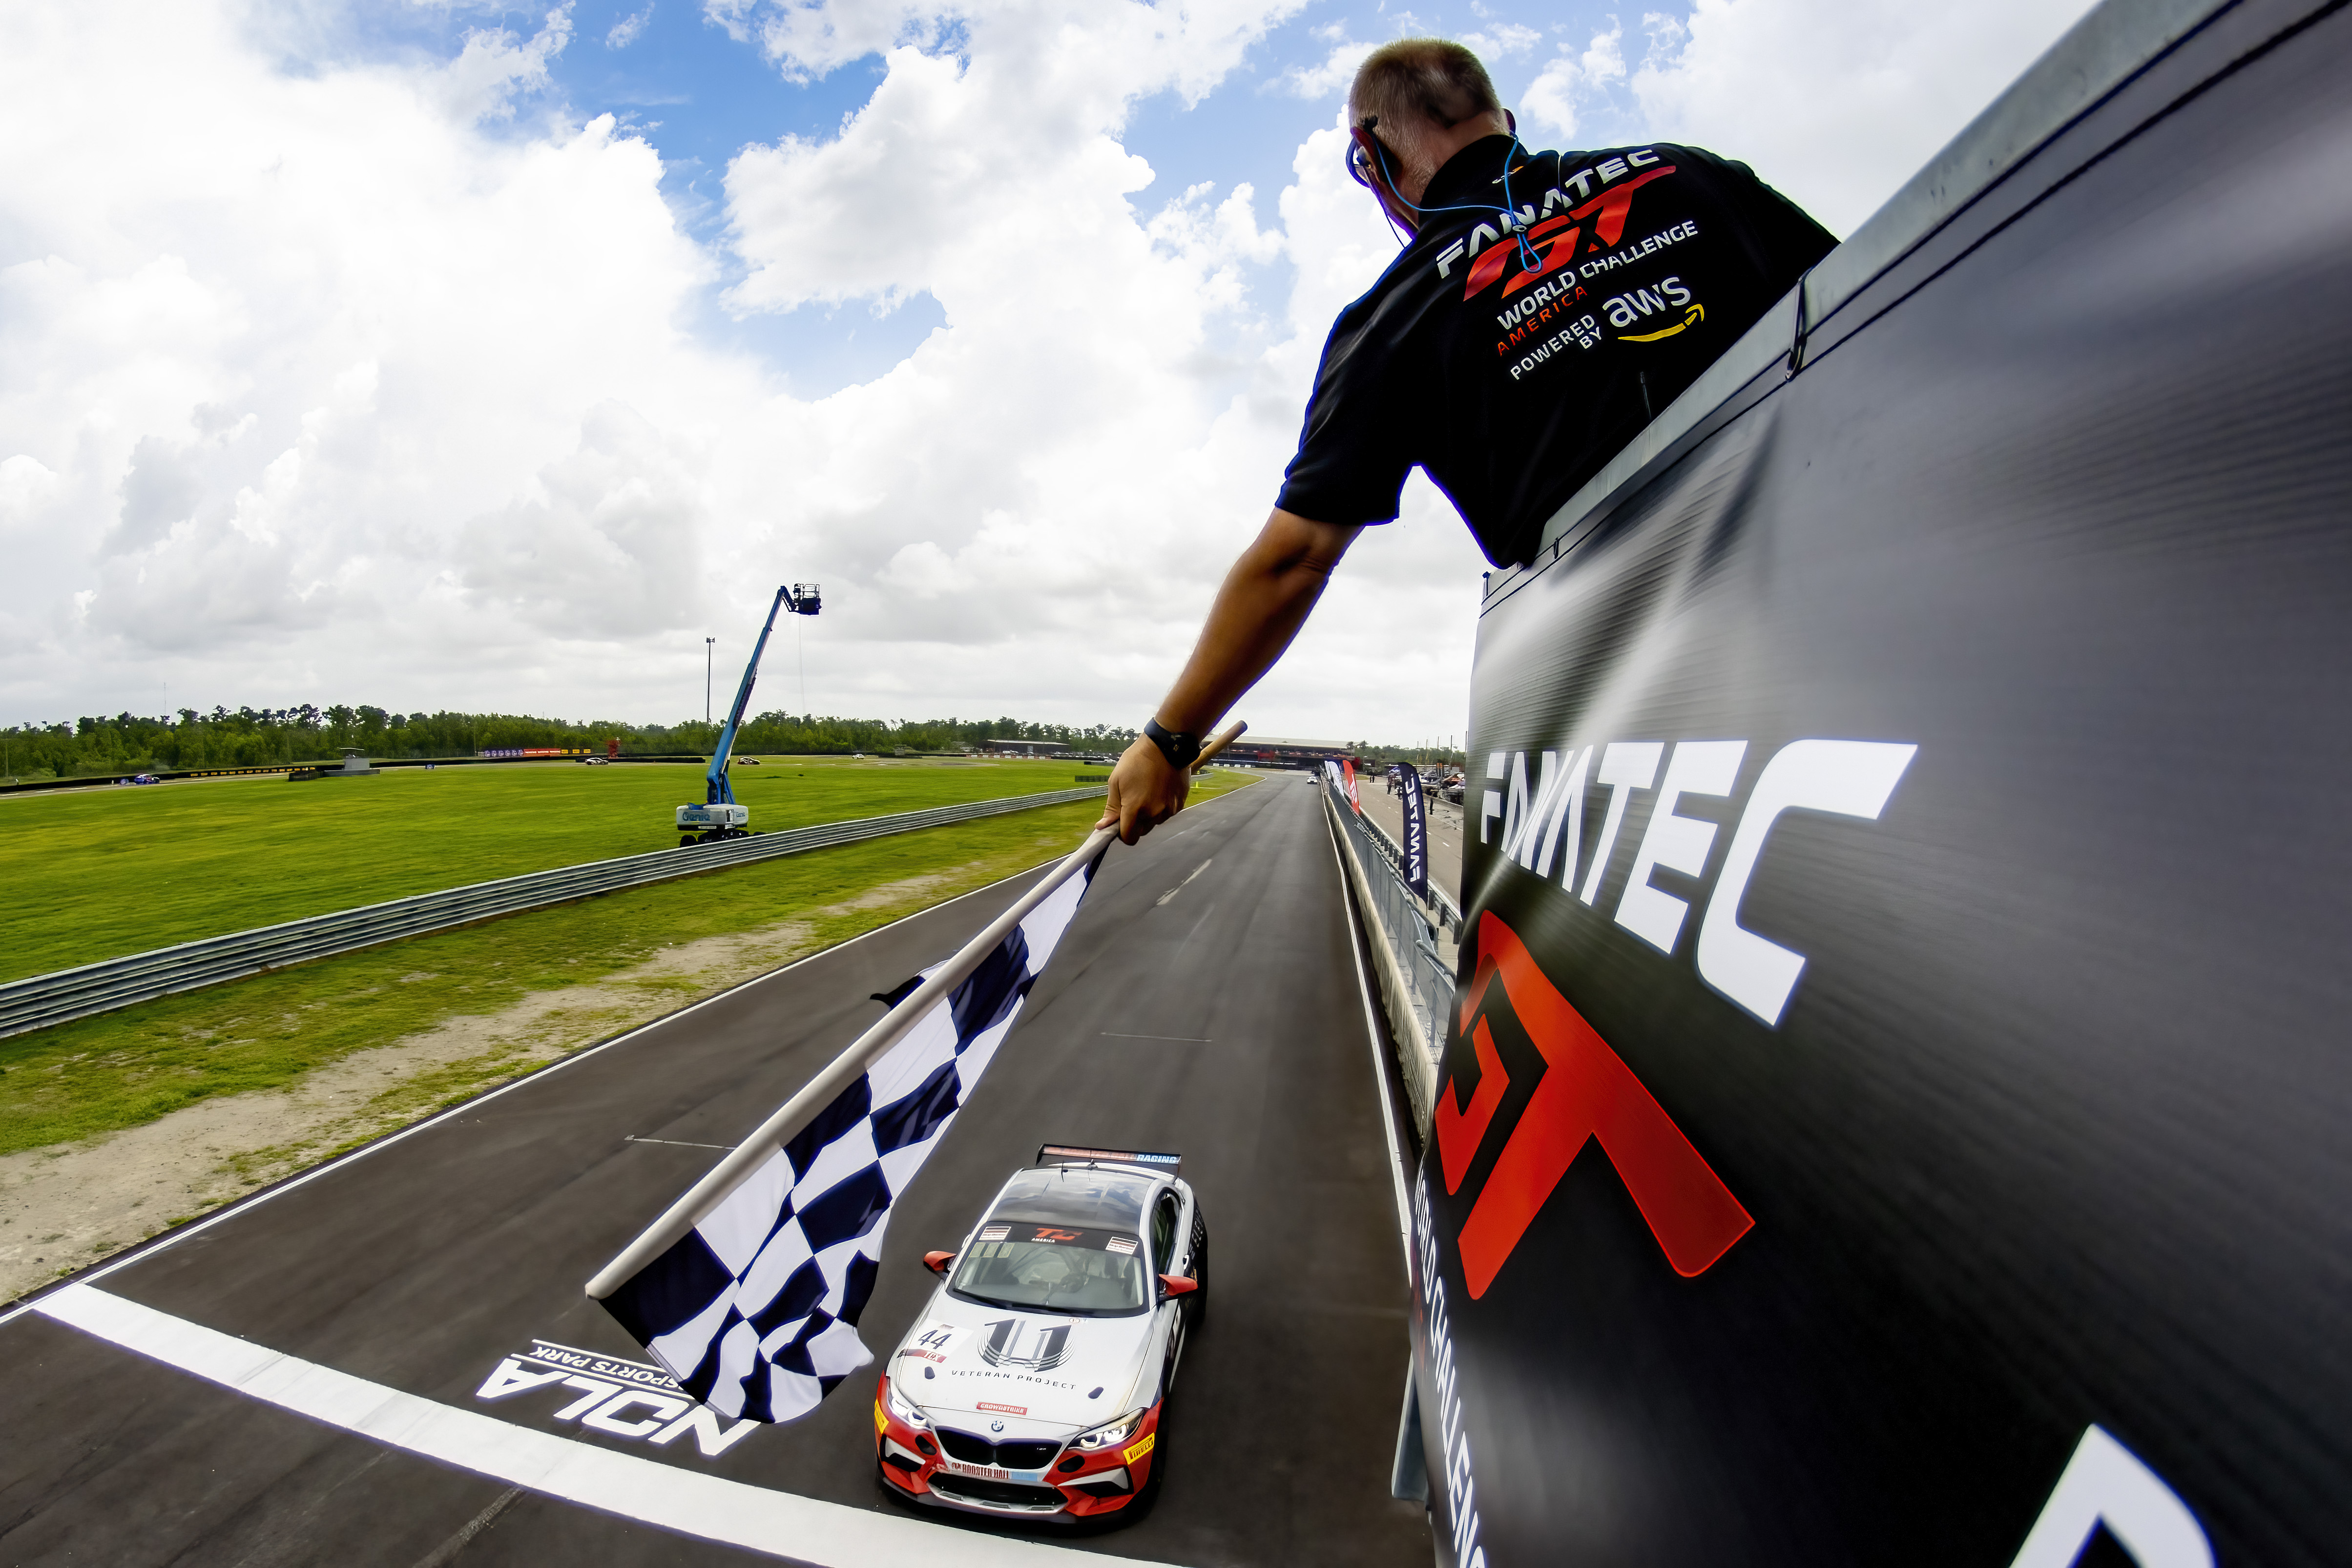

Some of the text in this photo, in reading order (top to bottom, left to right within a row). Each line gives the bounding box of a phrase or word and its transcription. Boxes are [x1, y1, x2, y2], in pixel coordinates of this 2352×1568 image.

[1436, 149, 1660, 279] FANATEC
[1497, 220, 1698, 330] WORLD CHALLENGE
[1602, 276, 1691, 327] aws
[1498, 286, 1587, 356] AMERICA
[1511, 314, 1595, 380] POWERED
[1580, 326, 1602, 349] BY
[1480, 739, 1918, 1026] FANATEC
[1137, 1154, 1177, 1164] RACING
[529, 1346, 684, 1390] SPORTS PARK
[918, 1329, 952, 1350] 44
[476, 1358, 761, 1456] NOLA
[951, 1370, 1076, 1390] VETERAN PROJECT
[1431, 1276, 1485, 1568] CHALLEN
